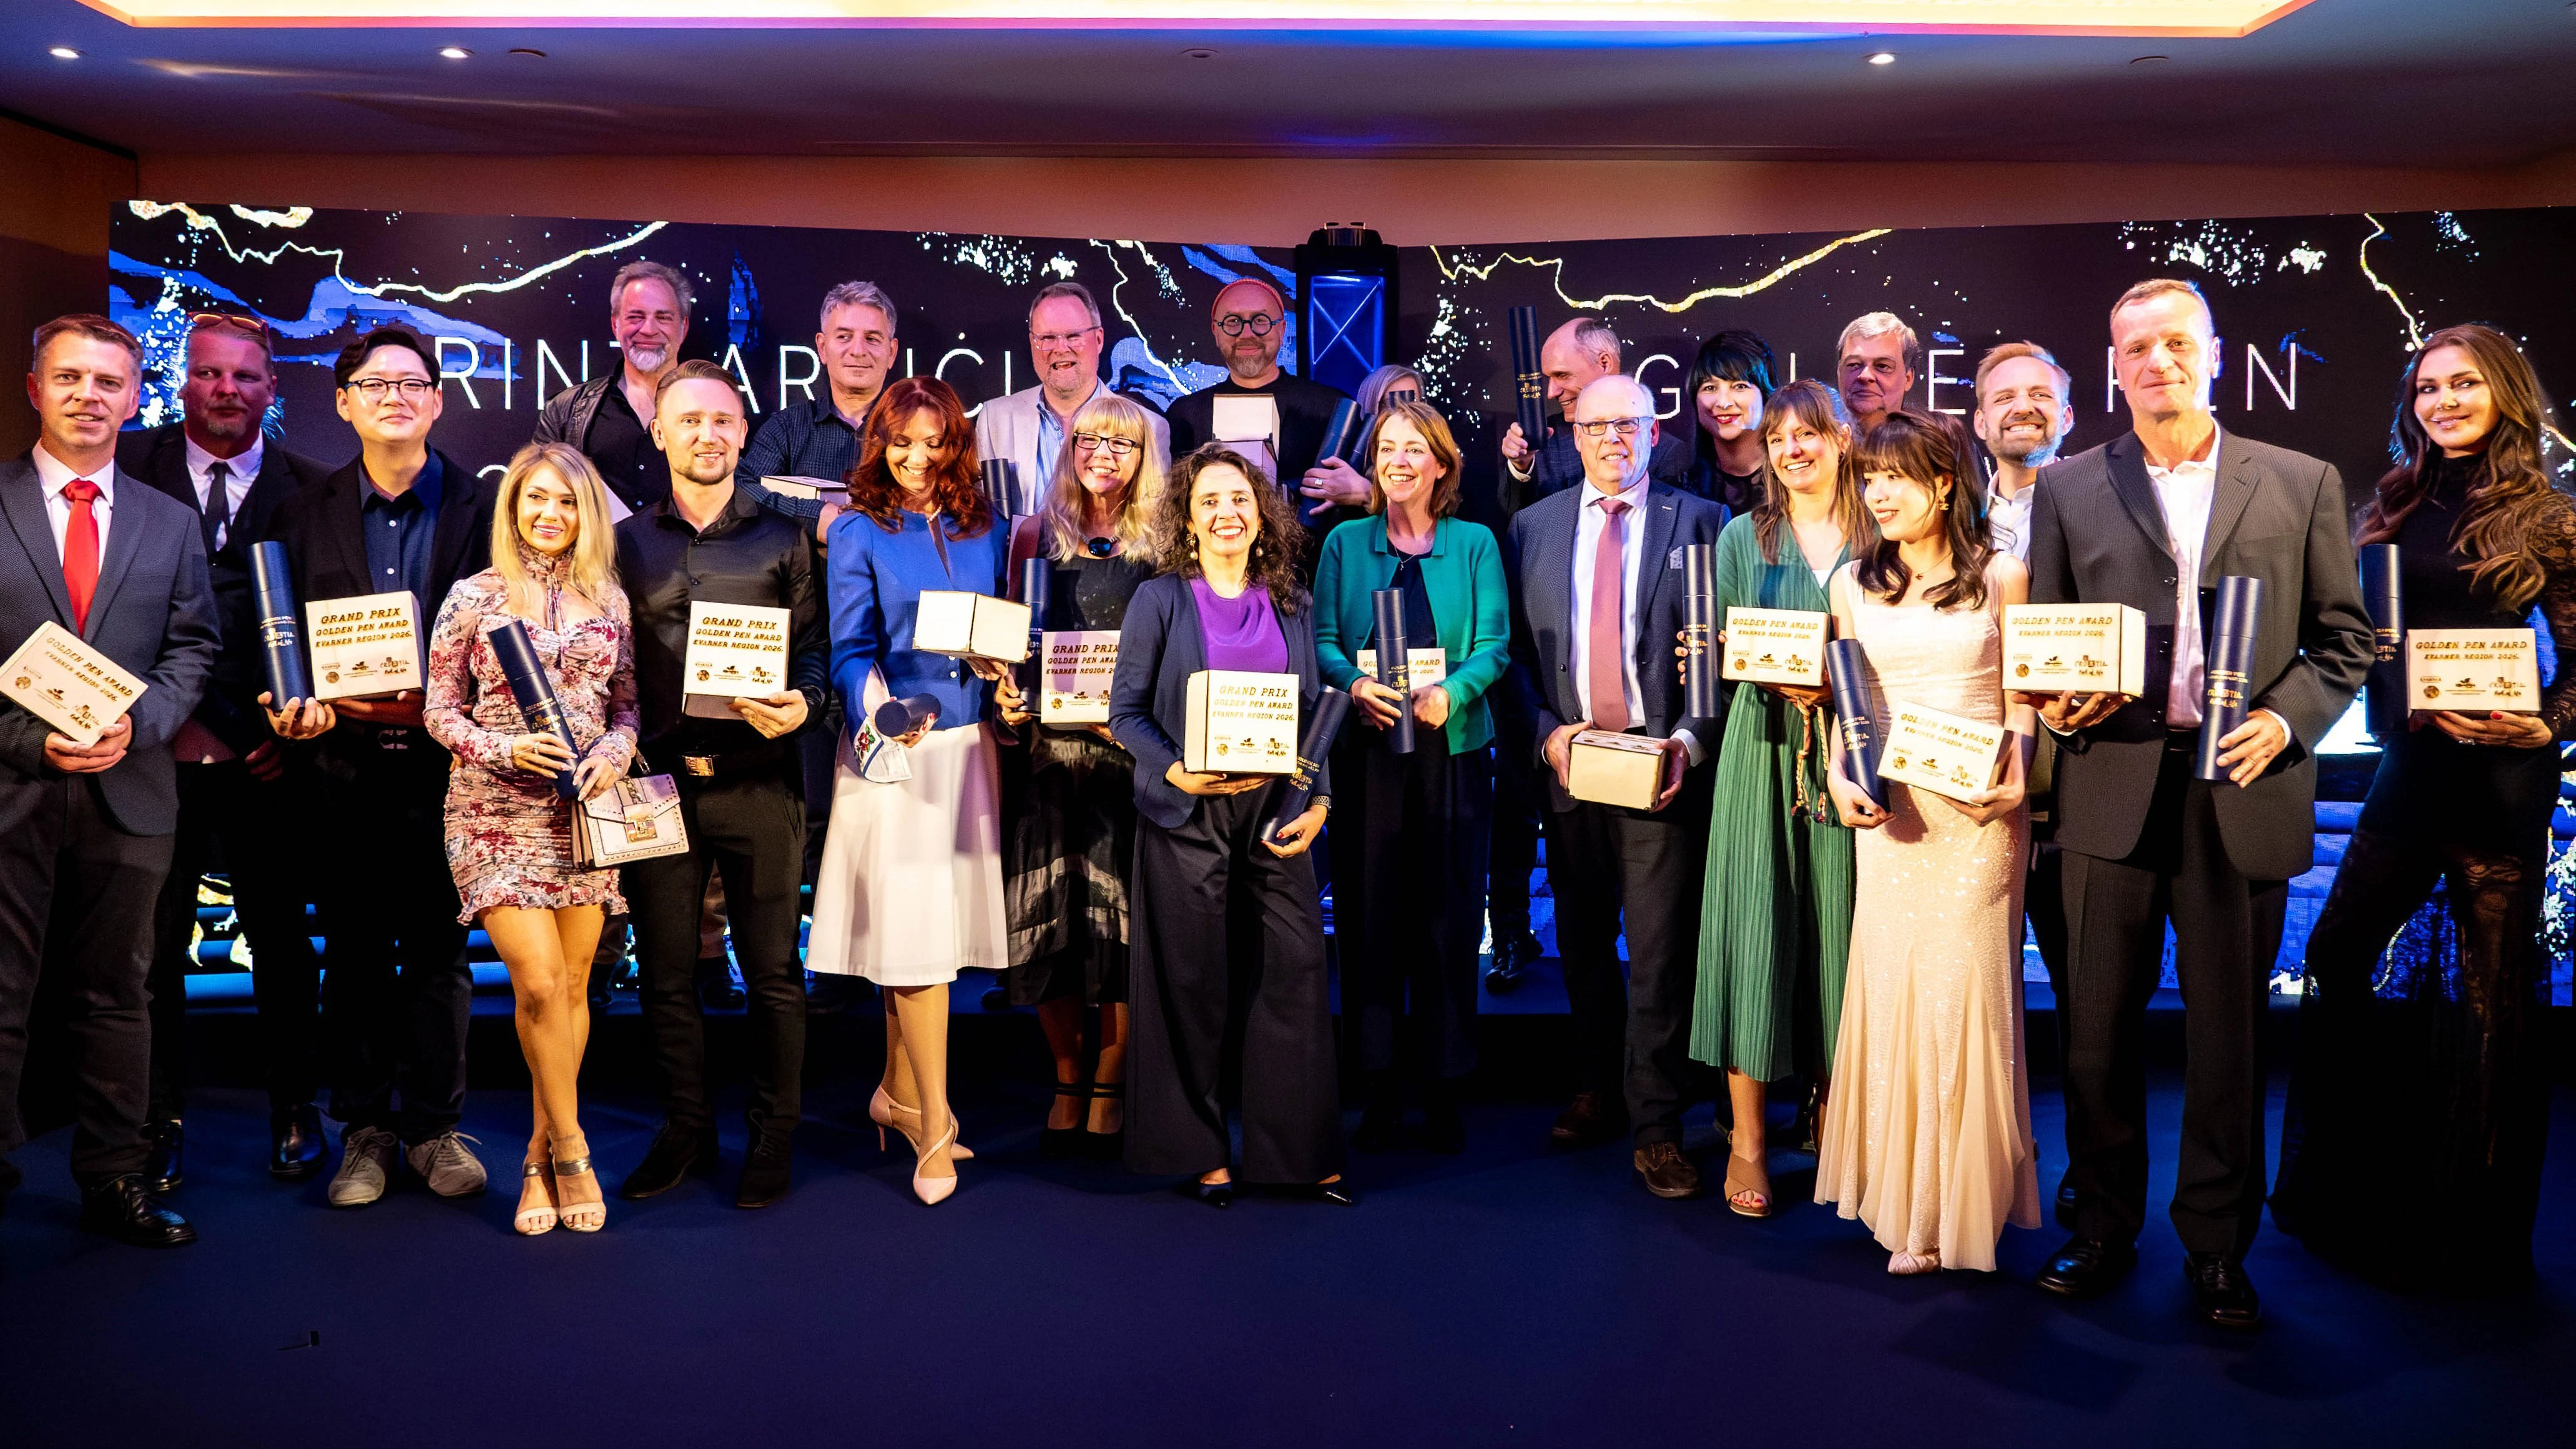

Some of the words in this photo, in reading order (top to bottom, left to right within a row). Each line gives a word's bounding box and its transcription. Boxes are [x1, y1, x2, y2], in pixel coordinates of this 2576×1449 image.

[321, 612, 363, 624] GRAND
[370, 608, 400, 619] PRIX
[2012, 617, 2050, 625] GOLDEN
[2079, 617, 2113, 625] AWARD
[316, 626, 353, 636] GOLDEN
[357, 623, 375, 632] PEN
[379, 620, 408, 629] AWARD
[702, 617, 742, 627] GRAND
[747, 621, 777, 630] PRIX
[1733, 618, 1766, 626] GOLDEN
[1790, 622, 1818, 630] AWARD
[696, 629, 731, 637] GOLDEN
[315, 637, 352, 647] KVARNER
[356, 634, 386, 643] REGION
[693, 639, 728, 647] KVARNER
[2416, 641, 2459, 649] GOLDEN
[1053, 644, 1089, 654] GRAND
[44, 651, 74, 672] KVARNER
[74, 672, 101, 688] REGION
[47, 637, 84, 663] GOLDEN
[84, 662, 104, 676] PEN
[104, 675, 133, 697] AWARD
[1219, 685, 1256, 696] GRAND
[1261, 687, 1288, 697] PRIX
[1214, 699, 1246, 707] GOLDEN
[1941, 724, 1960, 735] PEN
[1962, 732, 1993, 745] AWARD
